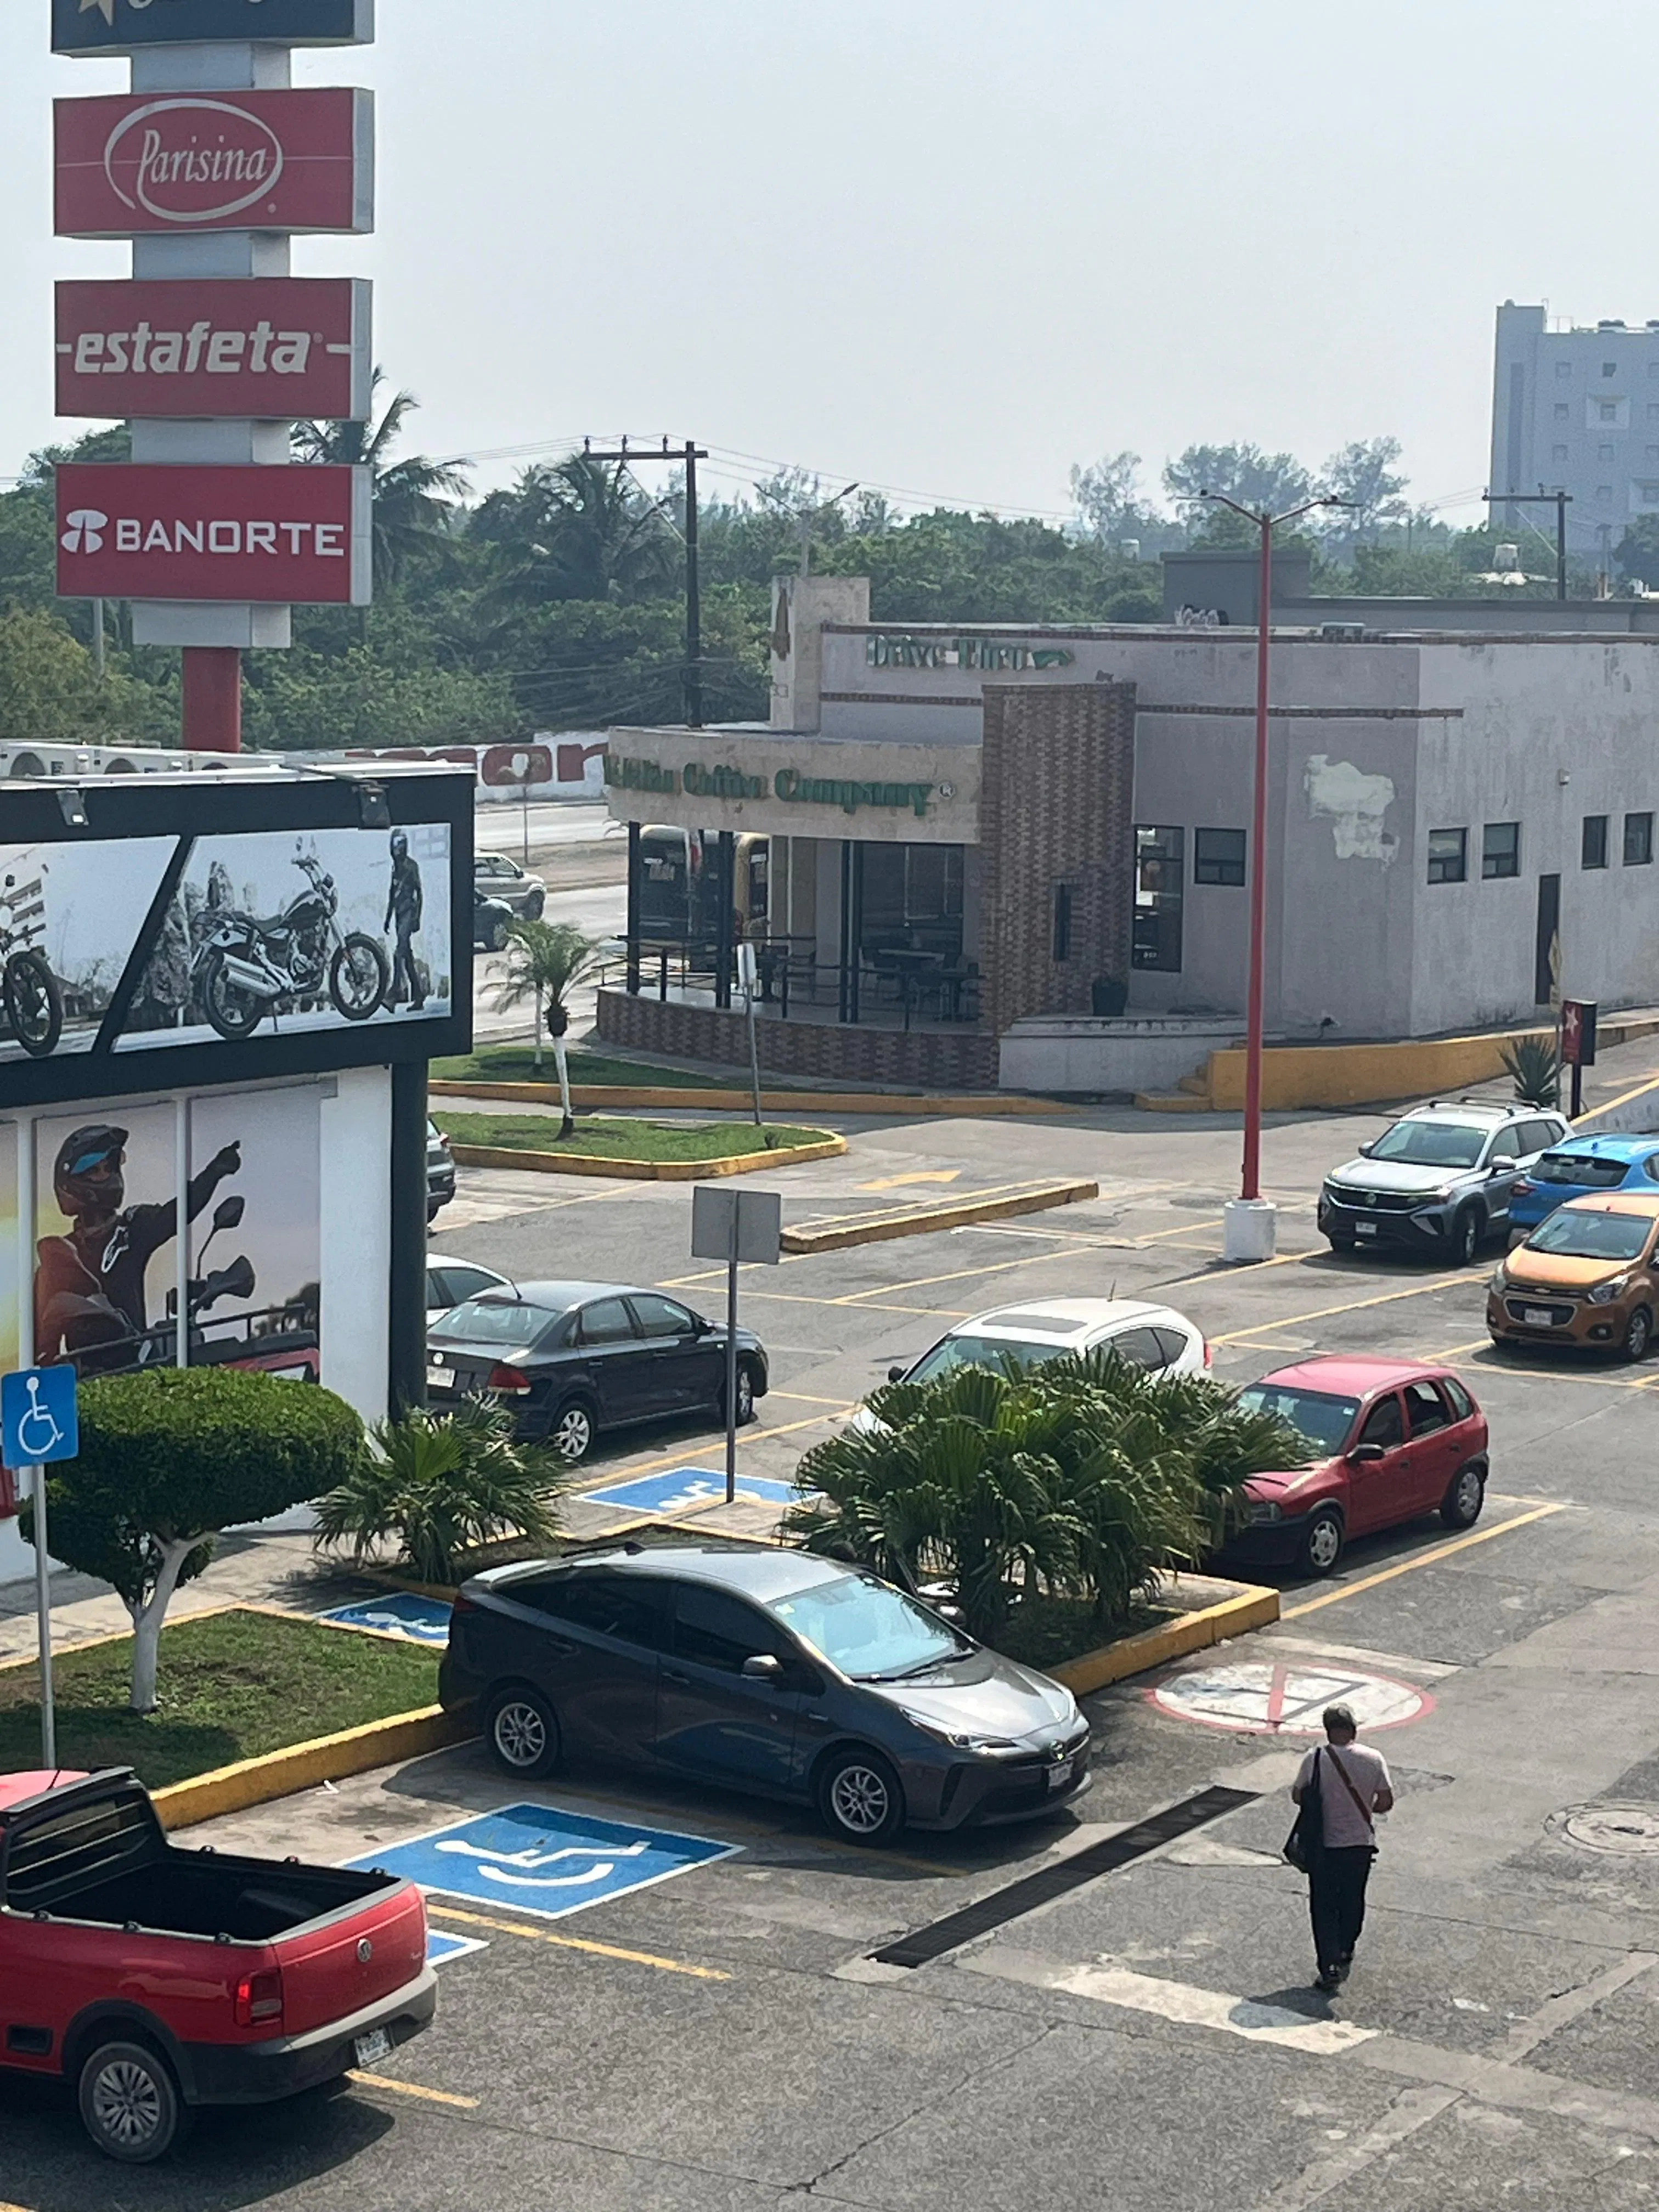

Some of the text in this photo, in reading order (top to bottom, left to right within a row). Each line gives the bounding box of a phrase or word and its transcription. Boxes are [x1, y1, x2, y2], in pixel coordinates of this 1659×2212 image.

[140, 129, 268, 184] Parisina
[75, 321, 311, 374] estafeta
[116, 519, 345, 556] BANORTE
